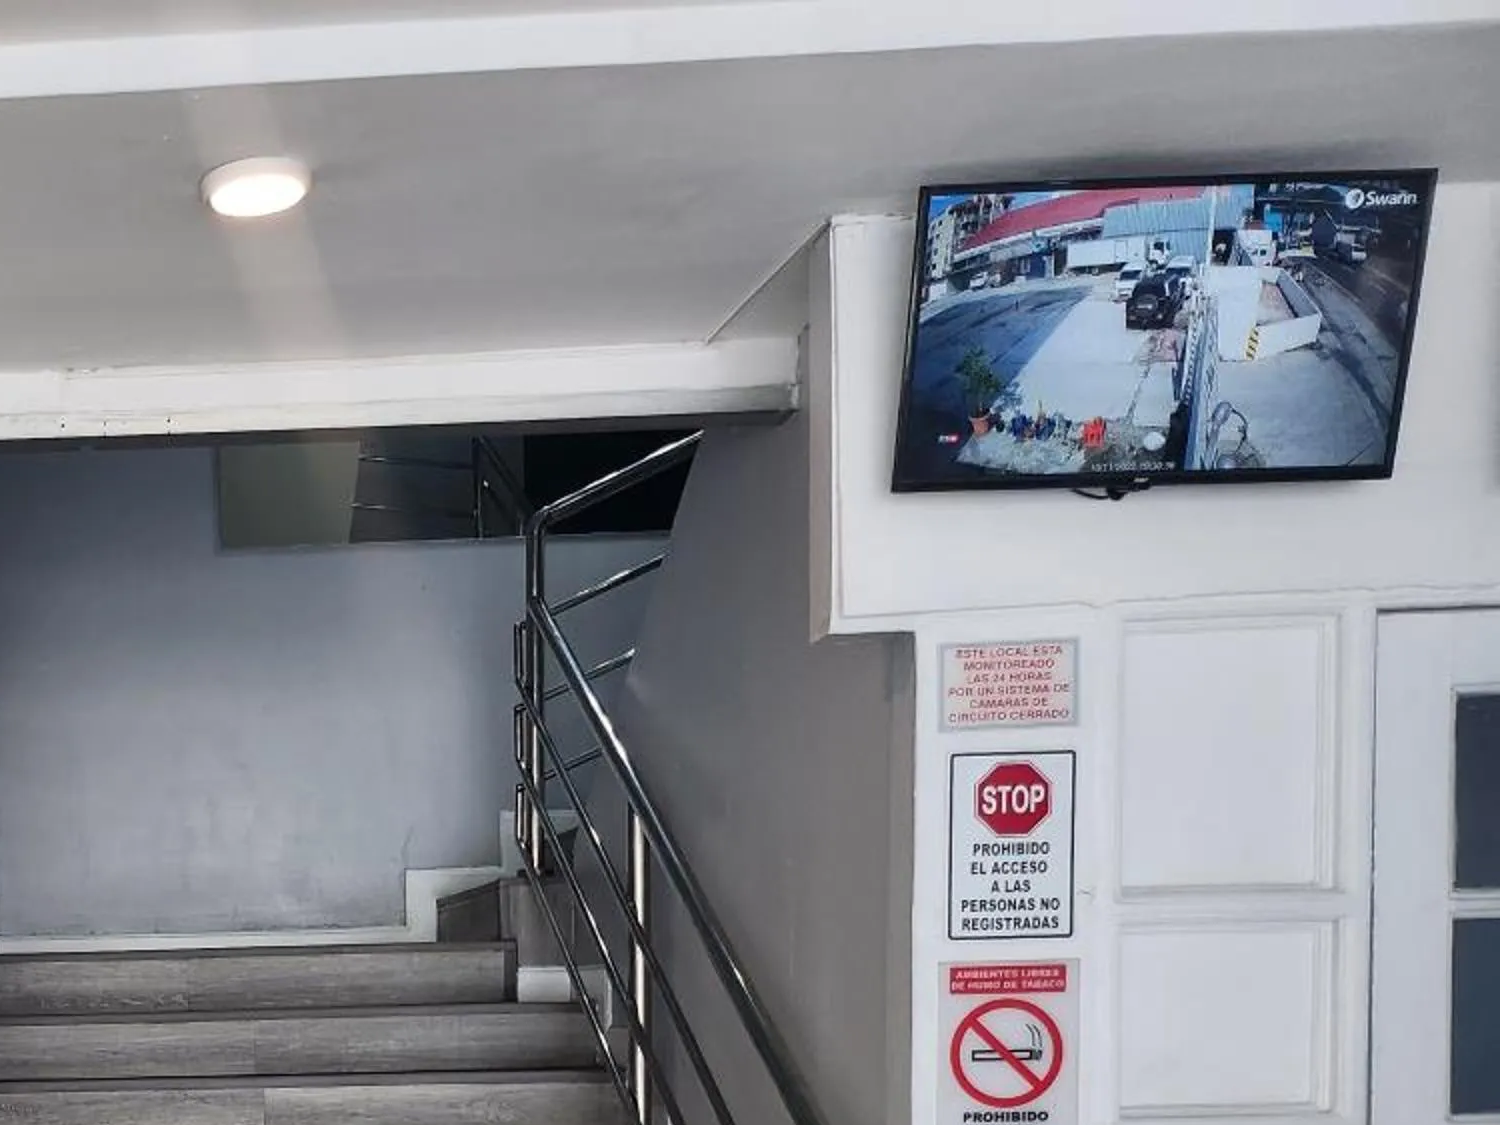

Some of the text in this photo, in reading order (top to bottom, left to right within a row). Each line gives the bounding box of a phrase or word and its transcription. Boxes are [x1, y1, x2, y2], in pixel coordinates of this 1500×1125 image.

[1366, 191, 1417, 206] Swann
[955, 645, 1063, 659] ESTE LOCAL ESTA
[963, 658, 1055, 671] MONITOREADO
[967, 671, 1052, 684] LAS 24 HORAS
[948, 683, 1070, 697] POR UN SISTEMA DE
[970, 697, 1049, 709] CAMARAS DE
[948, 709, 1069, 723] CIRCUITO CERRADO
[982, 784, 1046, 815] STOP
[973, 842, 1051, 856] PROHIBIDO
[970, 861, 1048, 875] EL ACCESO
[991, 880, 1031, 893] A LAS
[961, 898, 1060, 912] PERSONAS NO
[962, 917, 1059, 931] REGISTRADAS
[952, 981, 965, 990] DE
[1003, 980, 1017, 989] DE
[1022, 979, 1064, 989] TABACO
[963, 1111, 1049, 1123] PROHIBIDO
